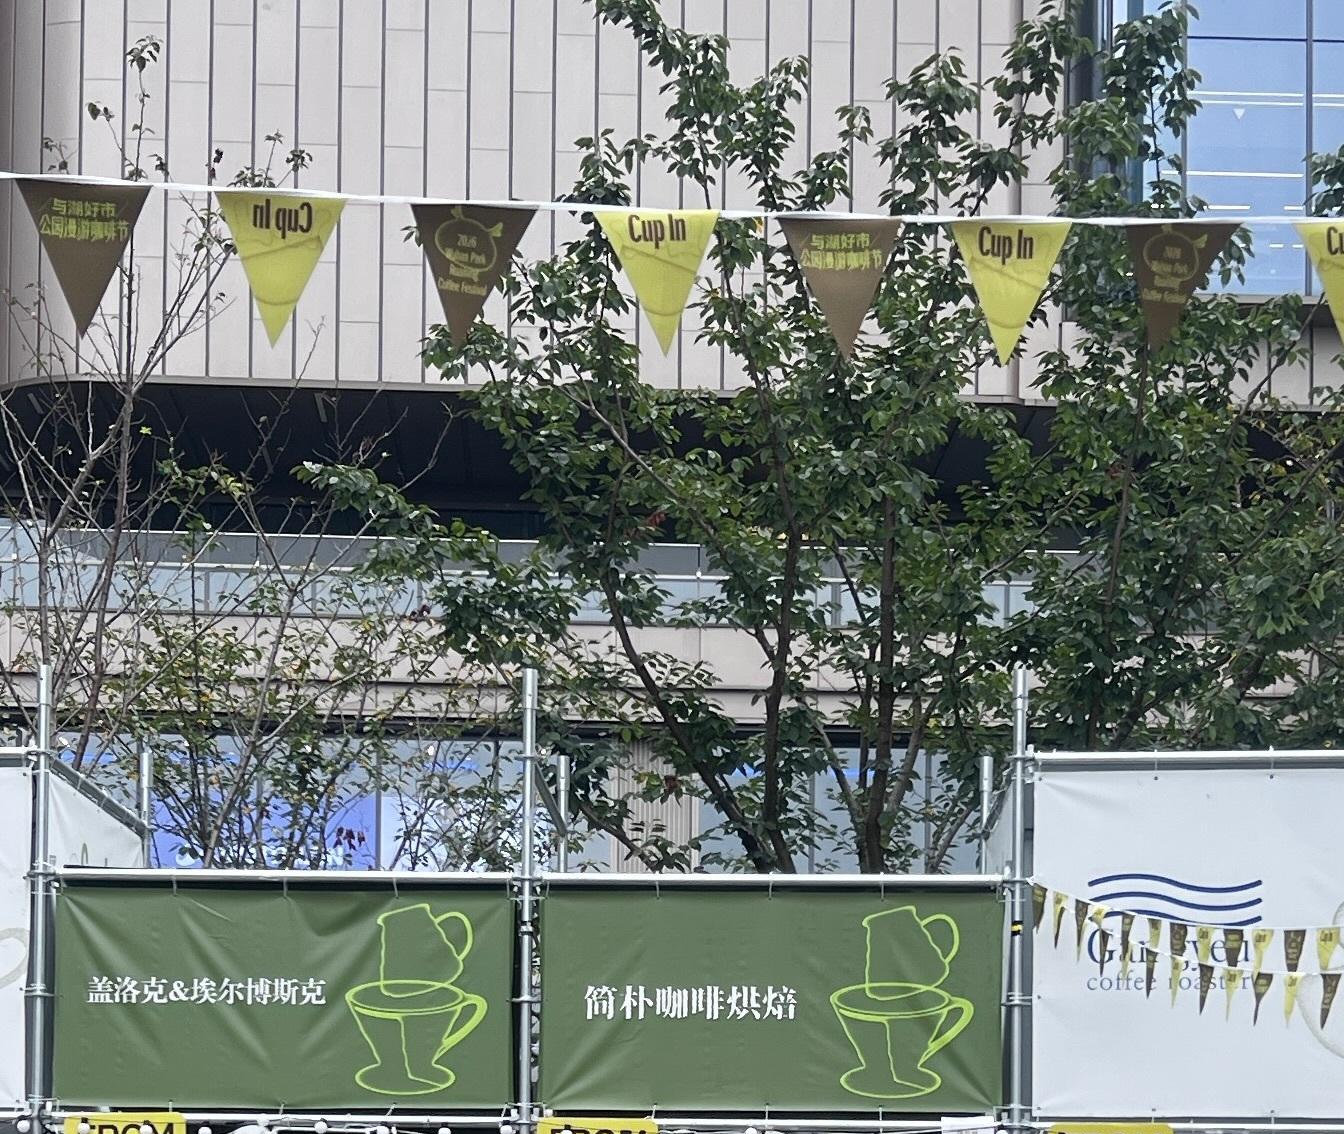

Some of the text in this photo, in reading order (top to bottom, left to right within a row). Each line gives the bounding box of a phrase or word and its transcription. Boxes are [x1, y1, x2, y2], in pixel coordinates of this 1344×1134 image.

[627, 214, 687, 248] Cup In
[978, 226, 1034, 265] Cup In
[87, 976, 327, 1006] 盖洛克&埃尔博斯克
[584, 986, 797, 1020] 简朴咖啡烘焙
